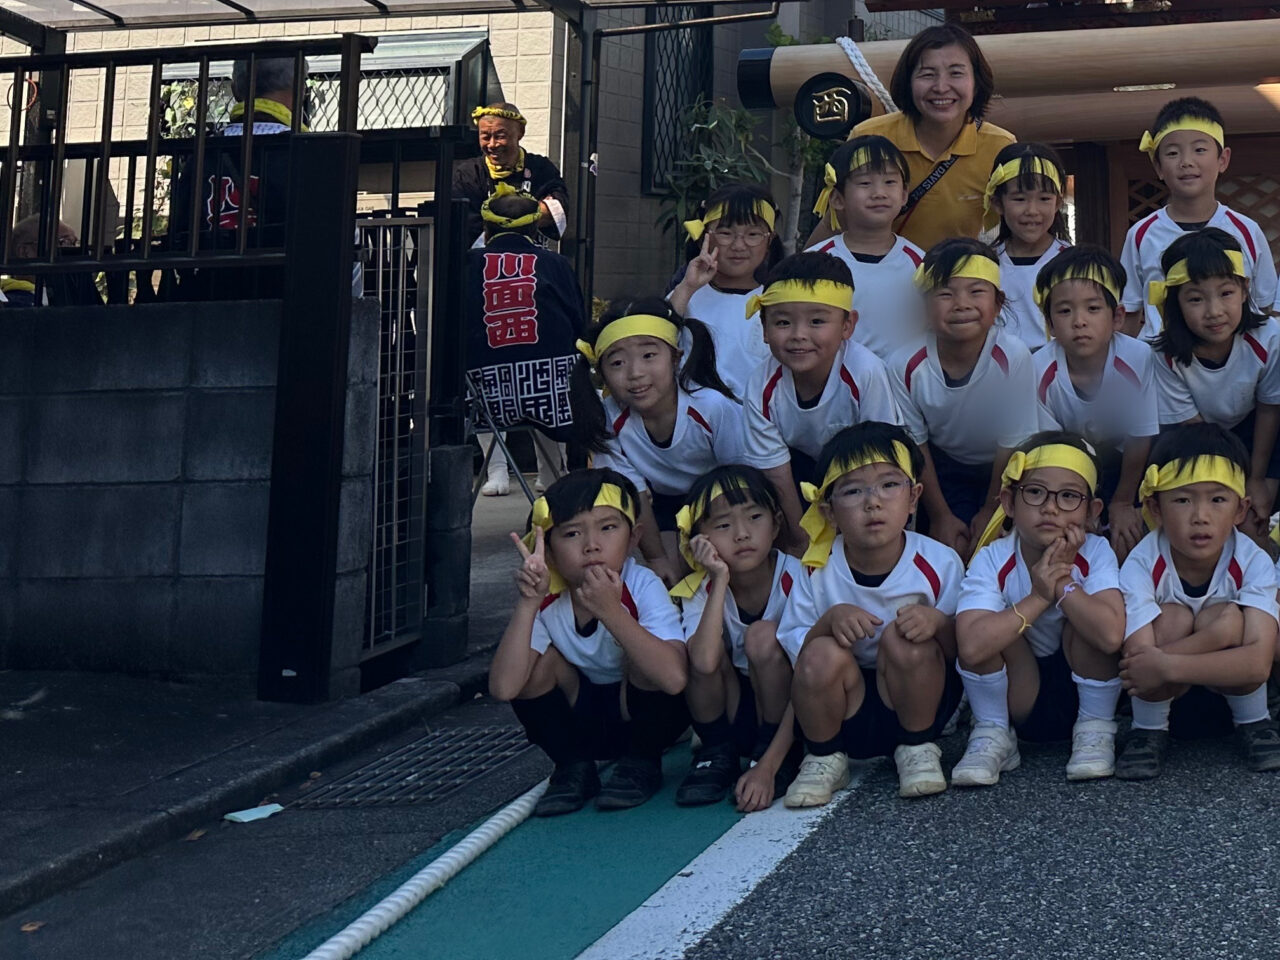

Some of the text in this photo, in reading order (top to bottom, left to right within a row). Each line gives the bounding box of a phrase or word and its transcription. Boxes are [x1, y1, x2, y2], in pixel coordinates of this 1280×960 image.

[811, 86, 852, 123] 西
[921, 165, 946, 190] DAVIS
[483, 252, 539, 349] 川面西
